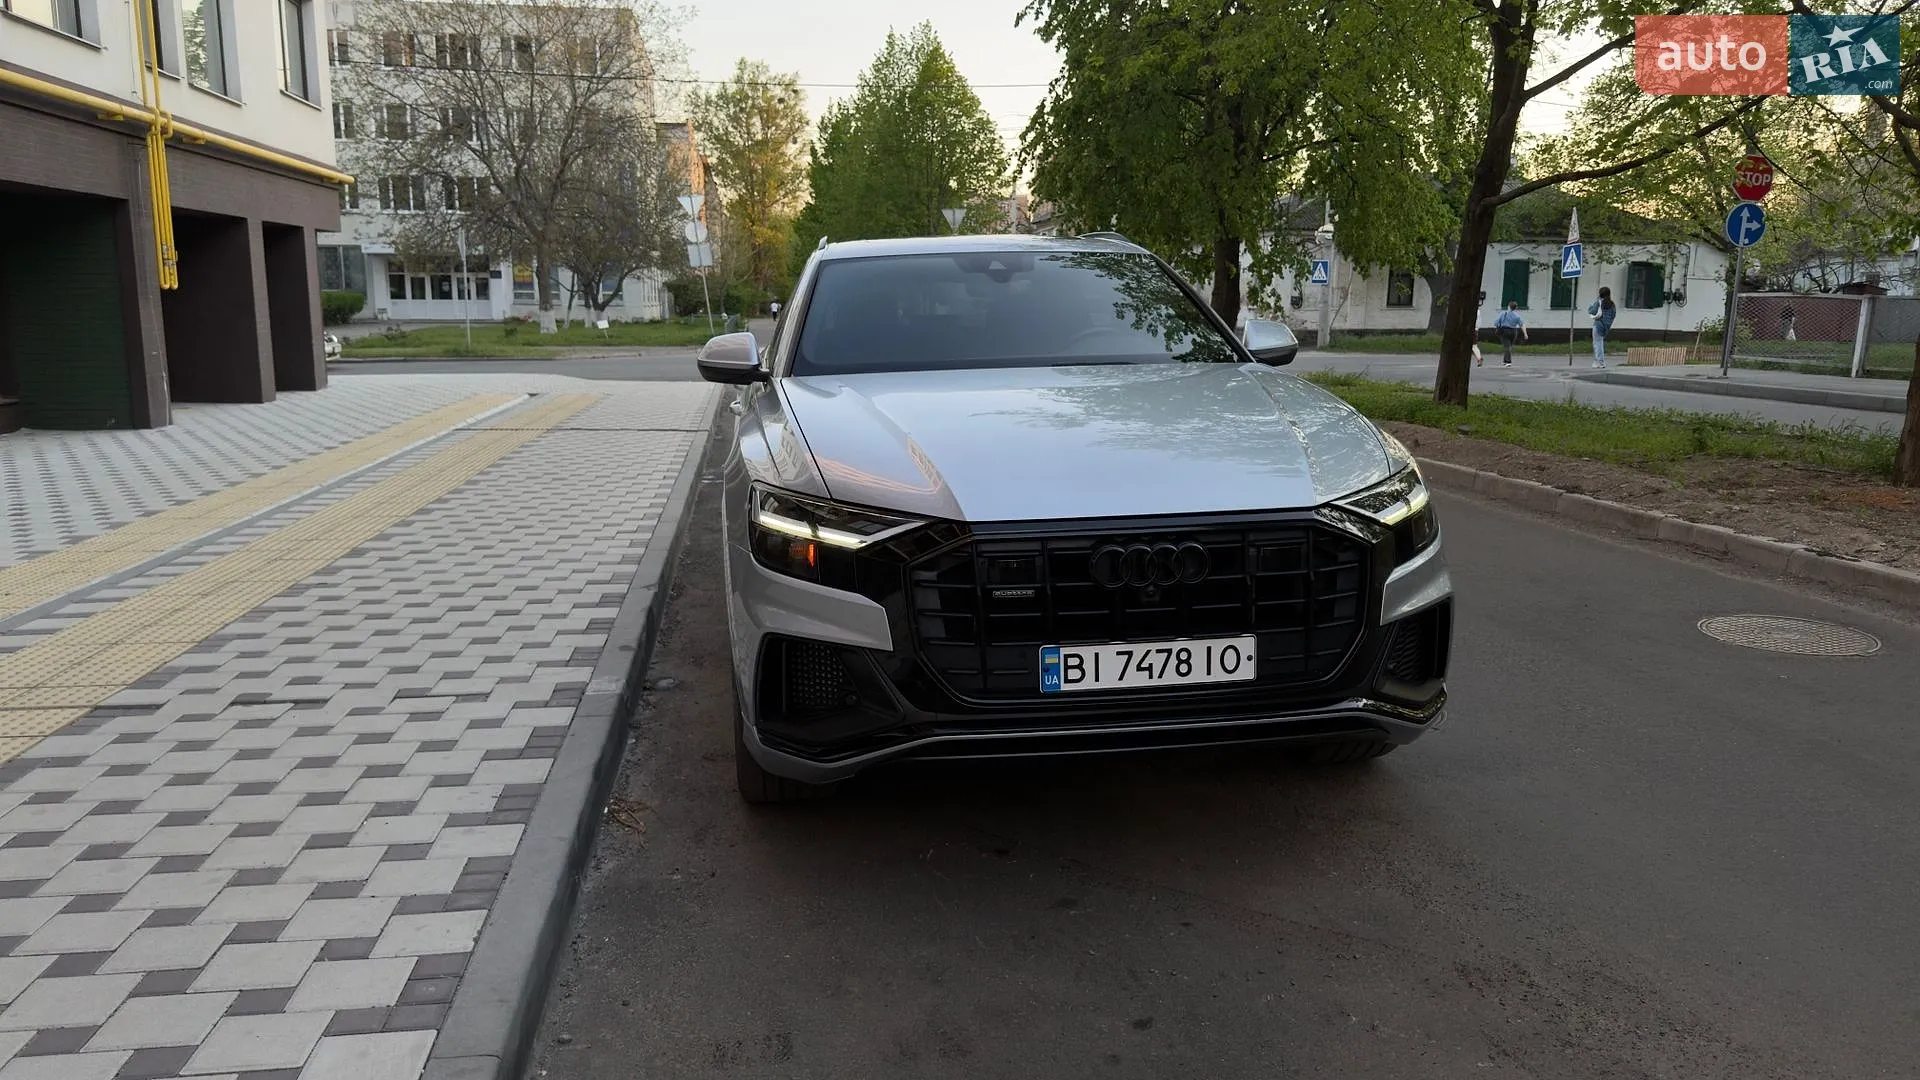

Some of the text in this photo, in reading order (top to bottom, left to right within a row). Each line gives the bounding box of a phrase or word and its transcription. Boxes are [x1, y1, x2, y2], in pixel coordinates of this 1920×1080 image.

[1736, 171, 1771, 187] STOP
[1063, 652, 1100, 684] BI
[1115, 648, 1193, 681] 7478
[1045, 676, 1059, 685] UA
